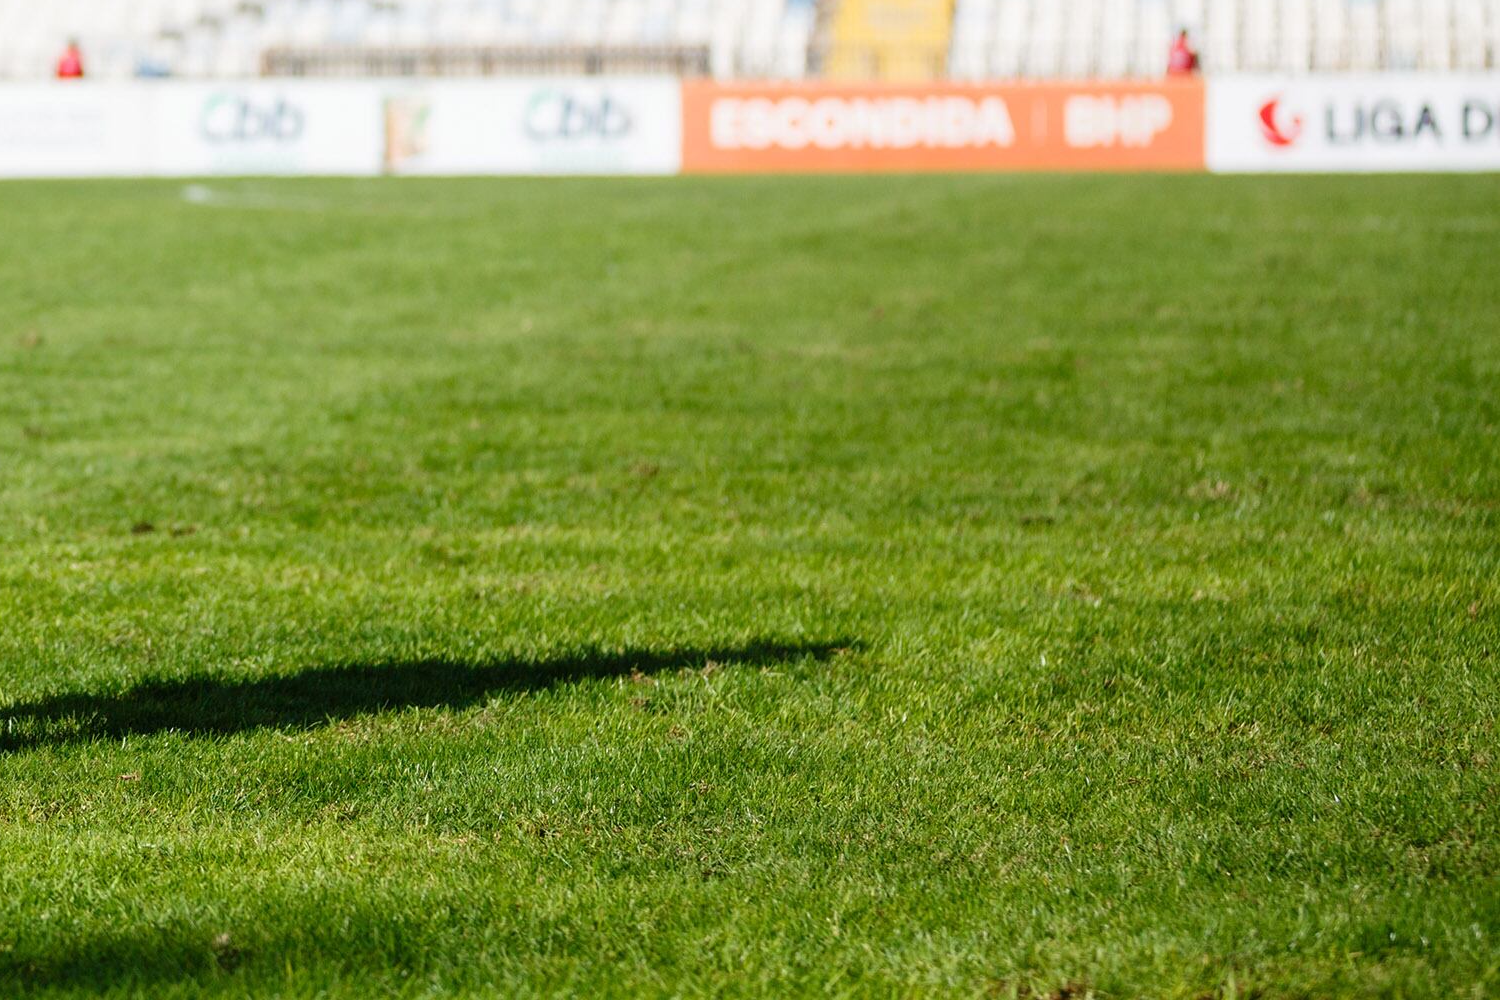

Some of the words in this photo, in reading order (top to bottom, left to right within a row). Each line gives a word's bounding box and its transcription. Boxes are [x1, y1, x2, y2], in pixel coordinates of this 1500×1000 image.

[710, 97, 1015, 149] ESCONDIDA
[1063, 94, 1173, 148] BHP
[1325, 98, 1441, 141] LIGA
